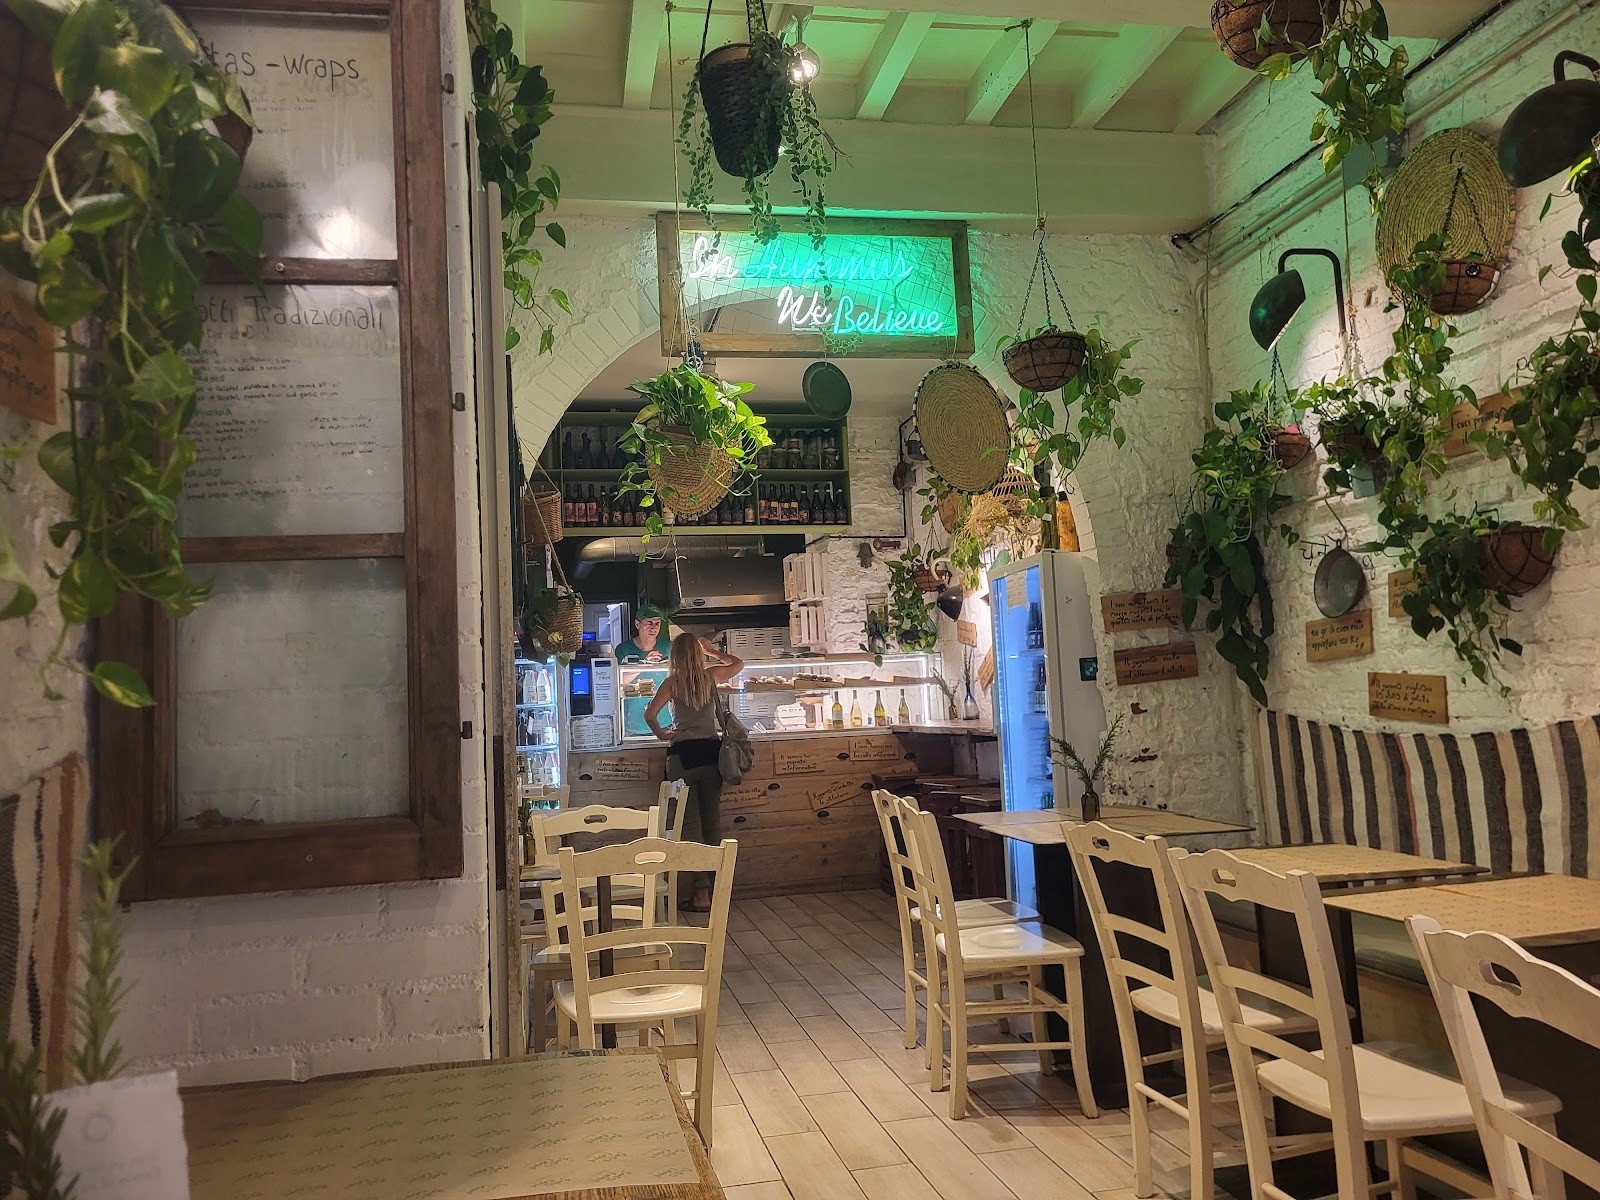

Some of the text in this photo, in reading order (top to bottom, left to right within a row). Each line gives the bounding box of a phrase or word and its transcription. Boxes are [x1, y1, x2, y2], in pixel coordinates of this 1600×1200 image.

[207, 42, 256, 77] tas
[689, 236, 914, 280] In Hummus
[243, 295, 384, 330] Tradizionali
[777, 286, 944, 335] We Believe
